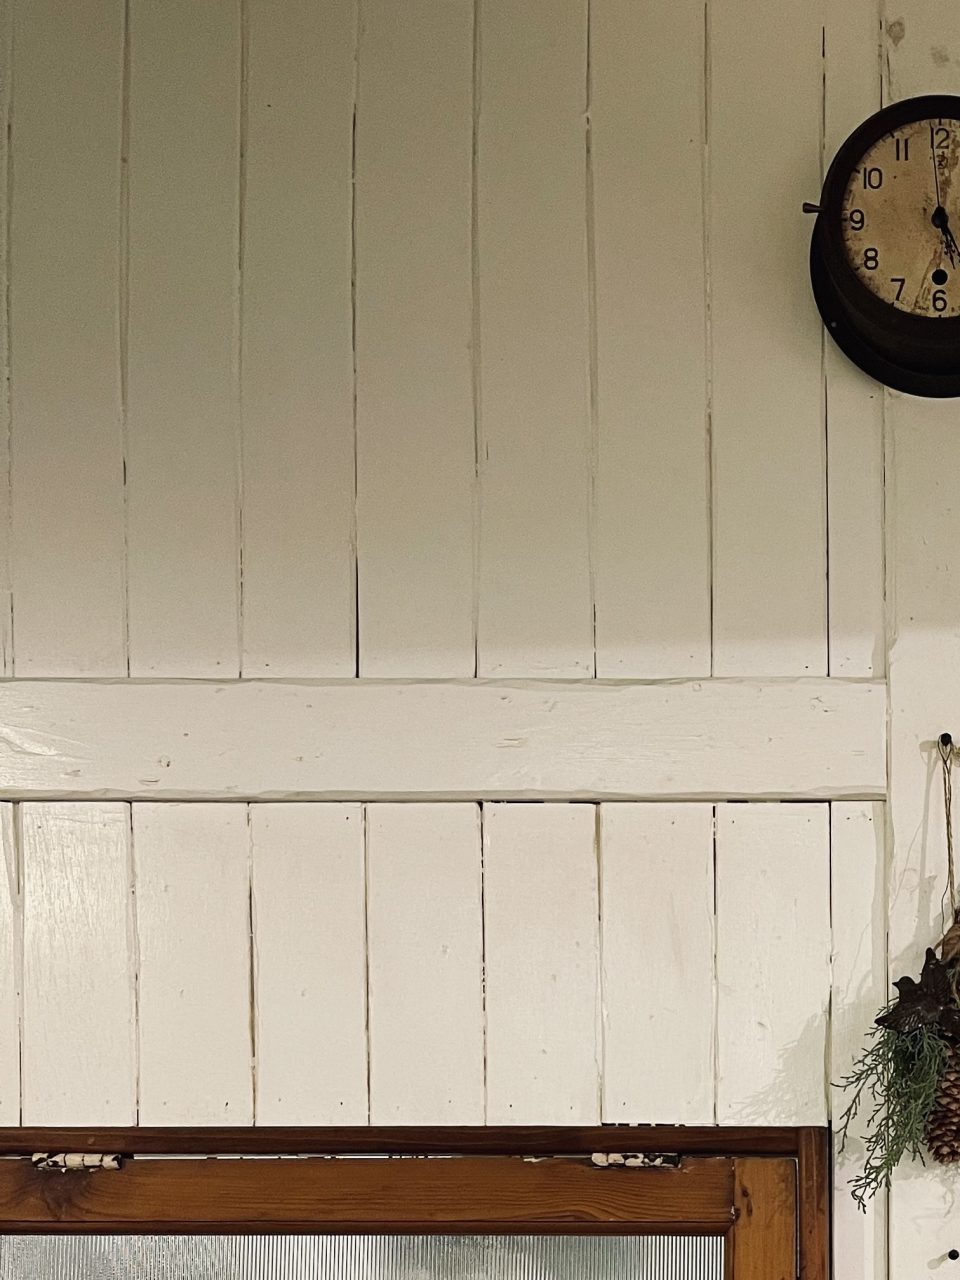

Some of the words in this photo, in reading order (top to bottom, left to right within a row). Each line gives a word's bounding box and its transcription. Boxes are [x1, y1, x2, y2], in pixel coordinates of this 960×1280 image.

[896, 138, 909, 161] 11
[863, 168, 883, 189] 10
[850, 209, 865, 231] 9
[863, 248, 879, 270] 8
[890, 278, 906, 301] 7
[932, 289, 948, 312] 6
